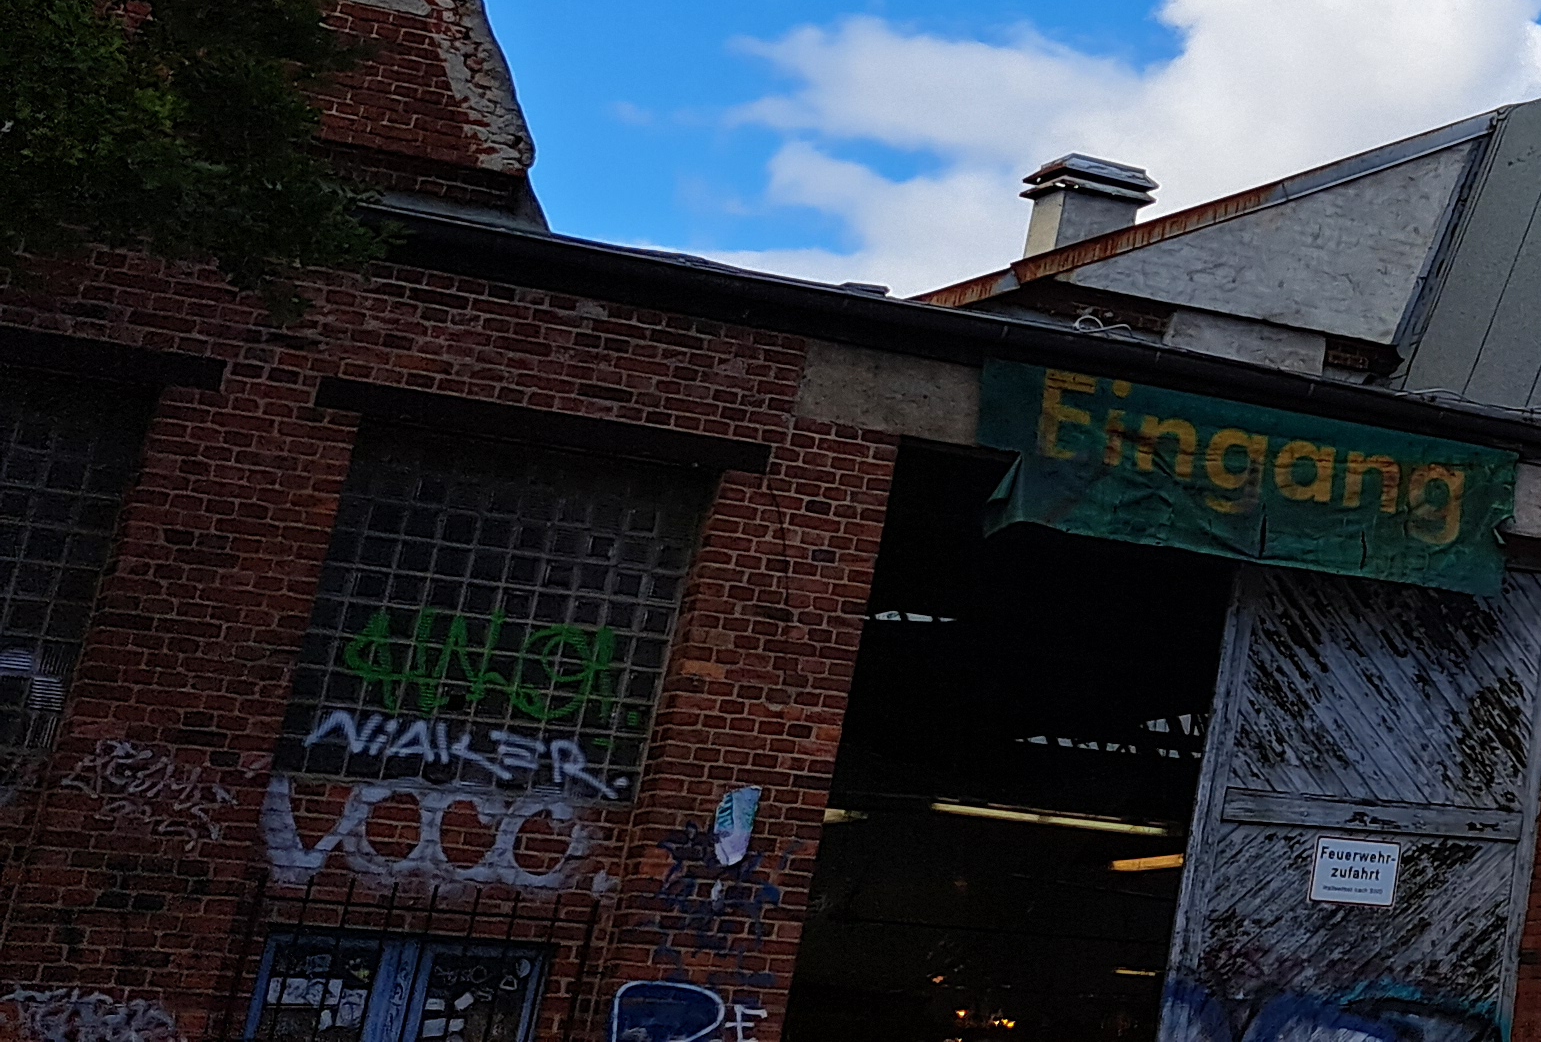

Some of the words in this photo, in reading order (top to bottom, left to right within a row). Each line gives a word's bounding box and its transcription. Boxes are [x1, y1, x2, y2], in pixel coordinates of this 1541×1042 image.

[1037, 368, 1465, 546] Eingang
[1320, 845, 1397, 865] Feuerwehr-
[1330, 865, 1381, 881] zufahrt
